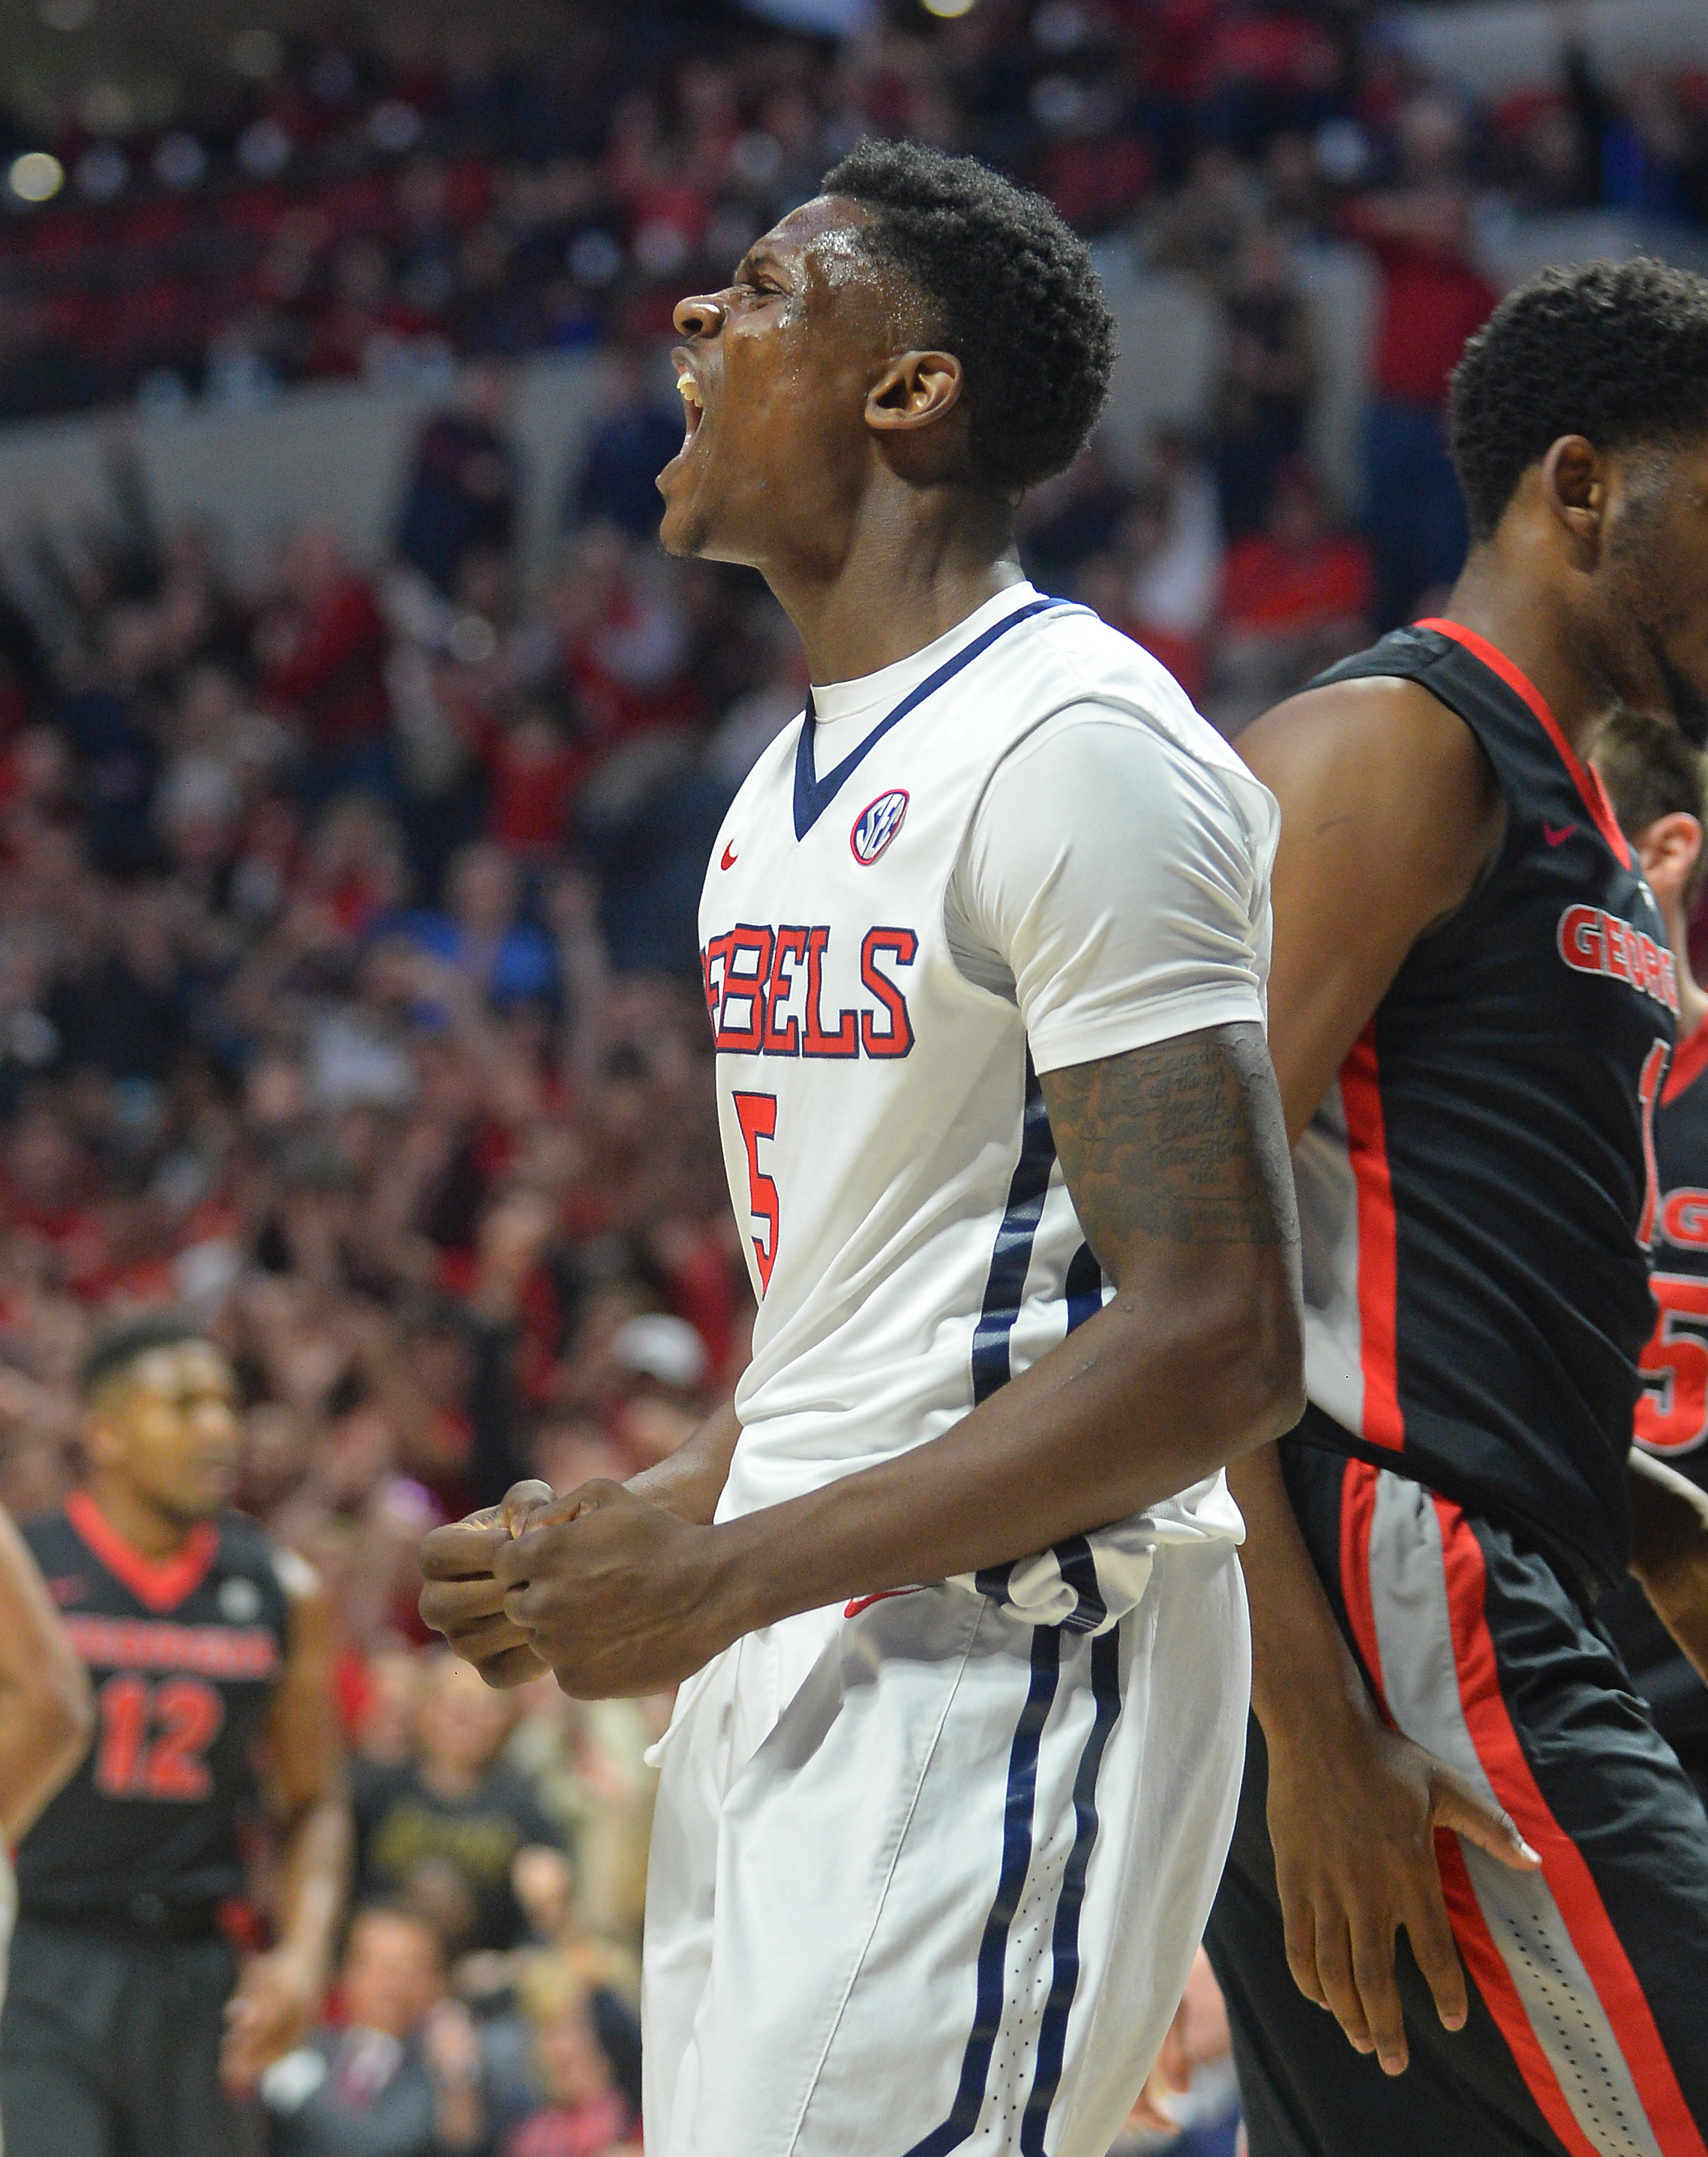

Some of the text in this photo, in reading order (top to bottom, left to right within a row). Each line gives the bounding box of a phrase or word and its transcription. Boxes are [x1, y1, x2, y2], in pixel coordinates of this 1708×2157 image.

[700, 923, 919, 1059] EBELS
[731, 1090, 779, 1302] 5
[1633, 1271, 1708, 1456] 5
[94, 1673, 223, 1799] 12
